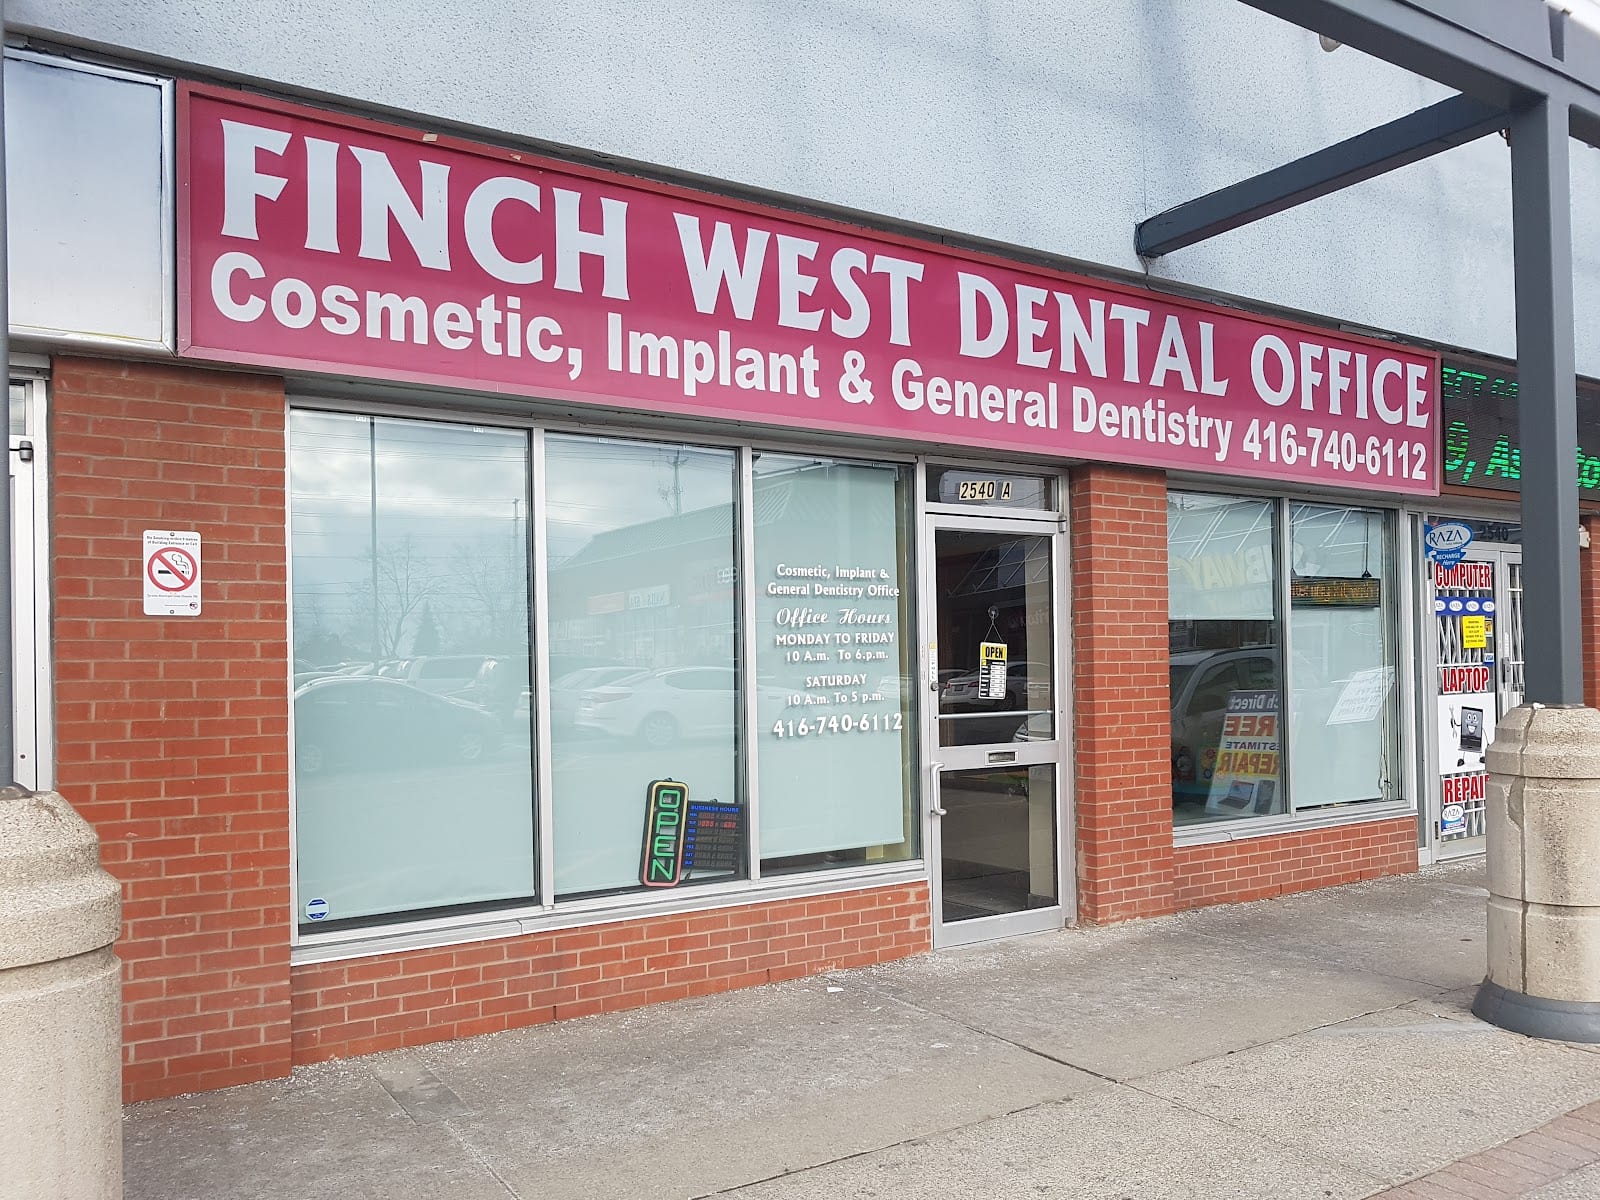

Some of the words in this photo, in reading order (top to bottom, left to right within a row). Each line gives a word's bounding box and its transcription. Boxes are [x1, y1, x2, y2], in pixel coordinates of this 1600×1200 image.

[221, 119, 629, 300] FINCH
[673, 212, 924, 346] WEST
[958, 272, 1228, 396] DENTAL
[1251, 335, 1429, 428] OFFICE
[211, 252, 582, 381] Cosmetic,
[608, 312, 820, 398] Implant
[839, 350, 874, 405] &
[892, 359, 1057, 429] General
[1073, 386, 1232, 460] Dentistry
[1243, 419, 1427, 480] 416-740-6112
[961, 482, 995, 499] 2540
[1002, 482, 1010, 497] A
[1429, 529, 1463, 545] RAZA
[1480, 525, 1509, 541] 2540
[777, 564, 831, 579] Cosmetic,
[836, 565, 876, 580] Implant
[879, 569, 890, 579] &
[1436, 564, 1491, 589] COMPUTER
[767, 583, 810, 596] General
[815, 584, 864, 598] Dentistry
[868, 585, 900, 597] Office
[777, 608, 829, 628] Office
[839, 608, 892, 625] Hours
[776, 634, 830, 646] MONDAY
[835, 633, 850, 644] TO
[856, 632, 895, 643] FRIDAY
[787, 651, 800, 662] 10
[804, 651, 830, 661] A.m.
[838, 649, 851, 660] To
[856, 649, 889, 661] 6.p.m.
[985, 646, 1004, 659] OPEN
[806, 674, 867, 687] SATURDAY
[1443, 667, 1489, 692] LAPTOP
[788, 694, 801, 705] 10
[804, 695, 830, 705] A.m.
[834, 692, 847, 702] To
[851, 692, 858, 702] 5
[862, 693, 885, 703] p.m.
[773, 713, 903, 738] 416-740-6112
[651, 789, 681, 881] OPEN
